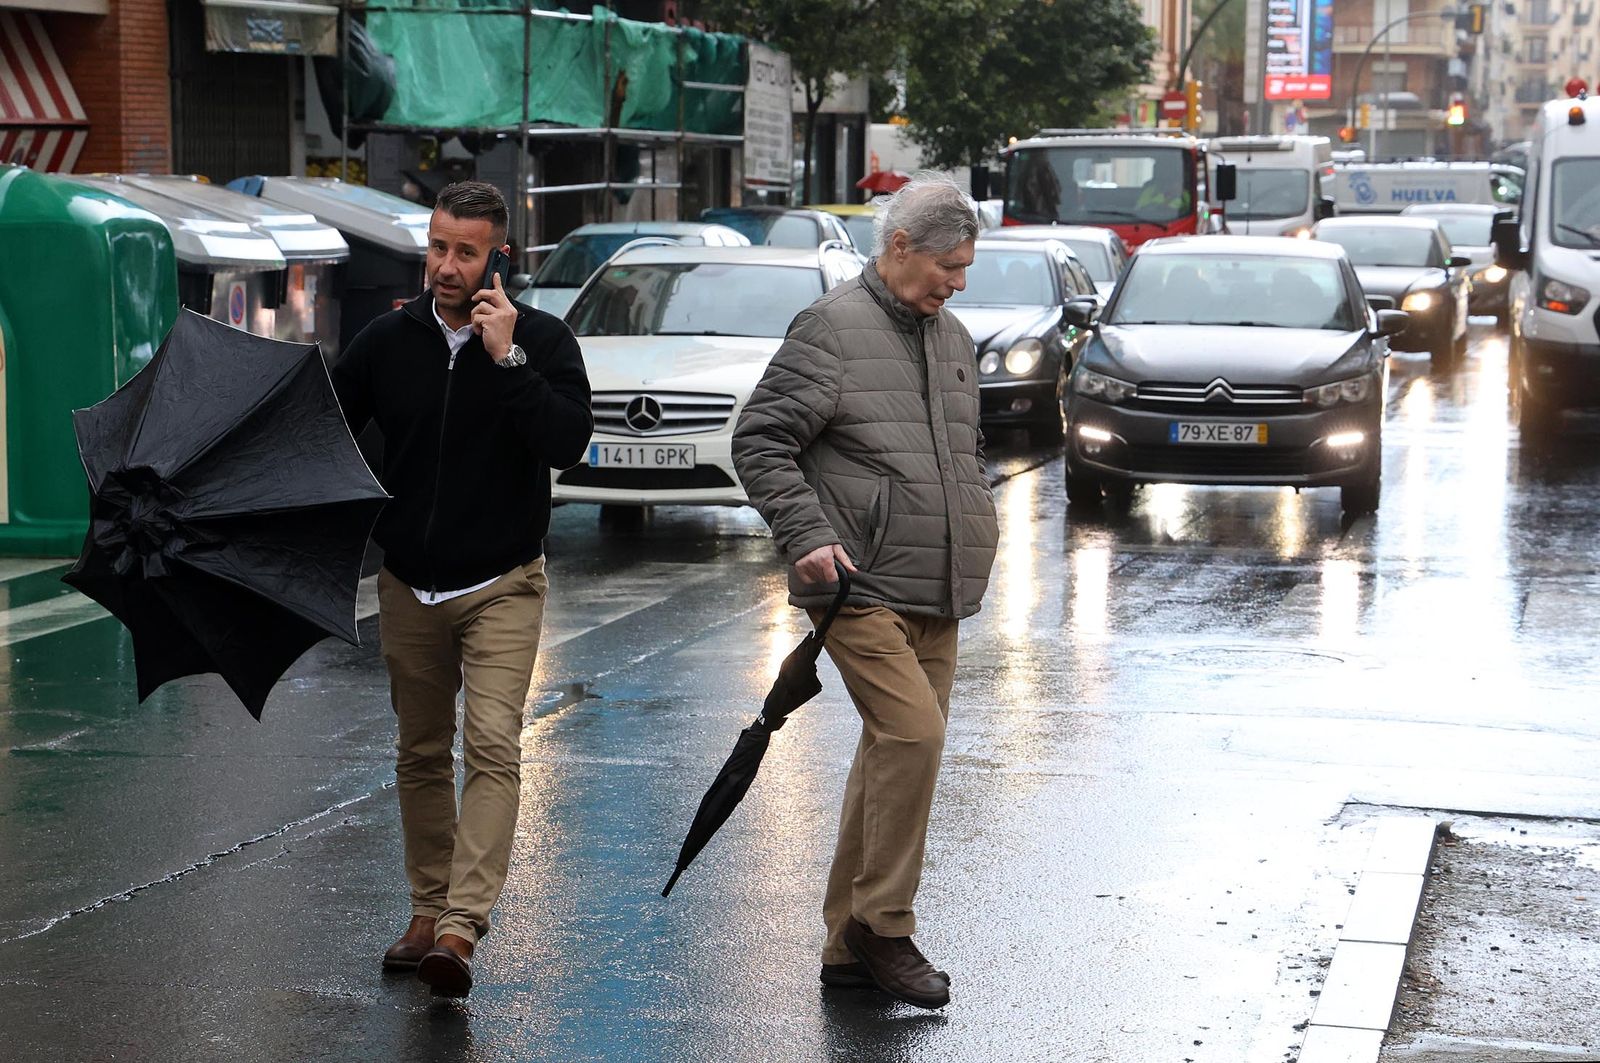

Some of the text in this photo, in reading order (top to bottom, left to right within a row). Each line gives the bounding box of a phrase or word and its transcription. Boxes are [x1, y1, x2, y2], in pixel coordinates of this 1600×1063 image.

[1391, 188, 1456, 202] HUELVA
[604, 447, 689, 465] 1411 GPK
